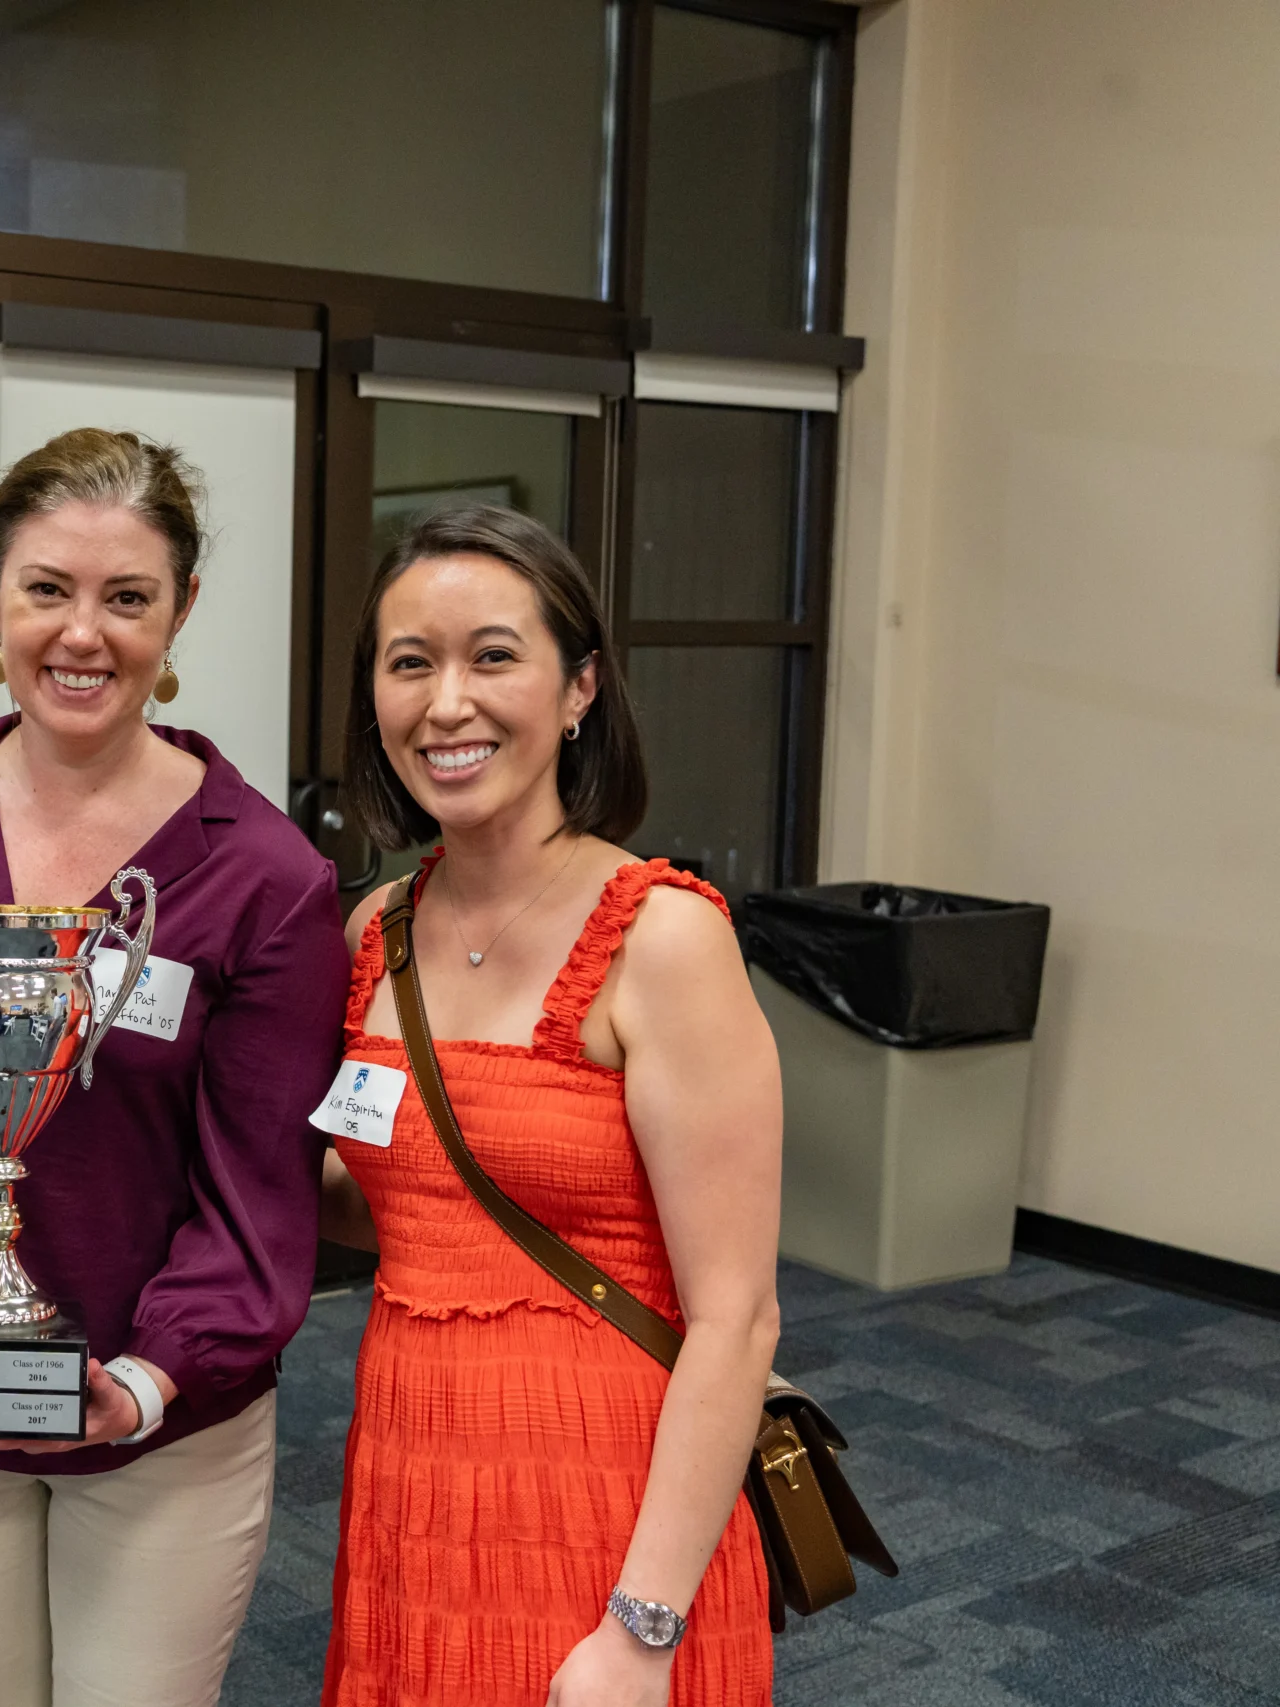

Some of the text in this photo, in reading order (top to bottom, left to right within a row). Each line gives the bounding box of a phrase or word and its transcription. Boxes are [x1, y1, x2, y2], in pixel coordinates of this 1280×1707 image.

[133, 991, 157, 1006] Pat
[99, 1004, 175, 1030] Sfford '05
[328, 1095, 383, 1120] Kim Espiritu
[343, 1117, 359, 1134] '05
[12, 1359, 64, 1369] Class of 1966
[28, 1374, 48, 1382] 2016
[11, 1402, 63, 1411] Class of 1987
[27, 1416, 47, 1424] 2017
